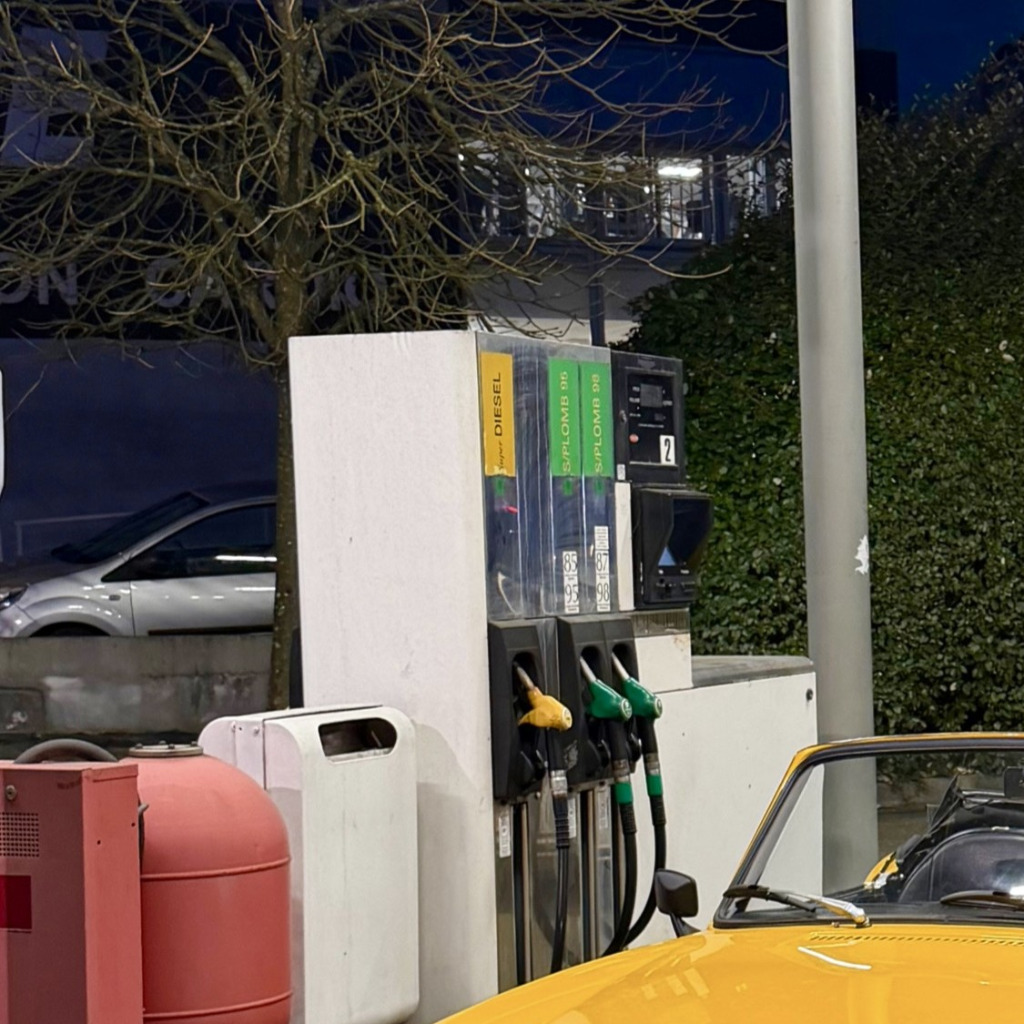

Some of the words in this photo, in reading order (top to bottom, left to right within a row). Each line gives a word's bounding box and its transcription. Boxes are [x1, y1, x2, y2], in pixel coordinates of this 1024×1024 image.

[591, 374, 600, 393] 98
[493, 372, 503, 437] DIESEL
[560, 395, 572, 473] S/PLOMB
[591, 397, 604, 473] S/PLOMB
[664, 438, 671, 462] 2
[563, 552, 578, 573] 85
[595, 552, 609, 572] 87
[564, 584, 579, 604] 95
[596, 583, 610, 603] 98
